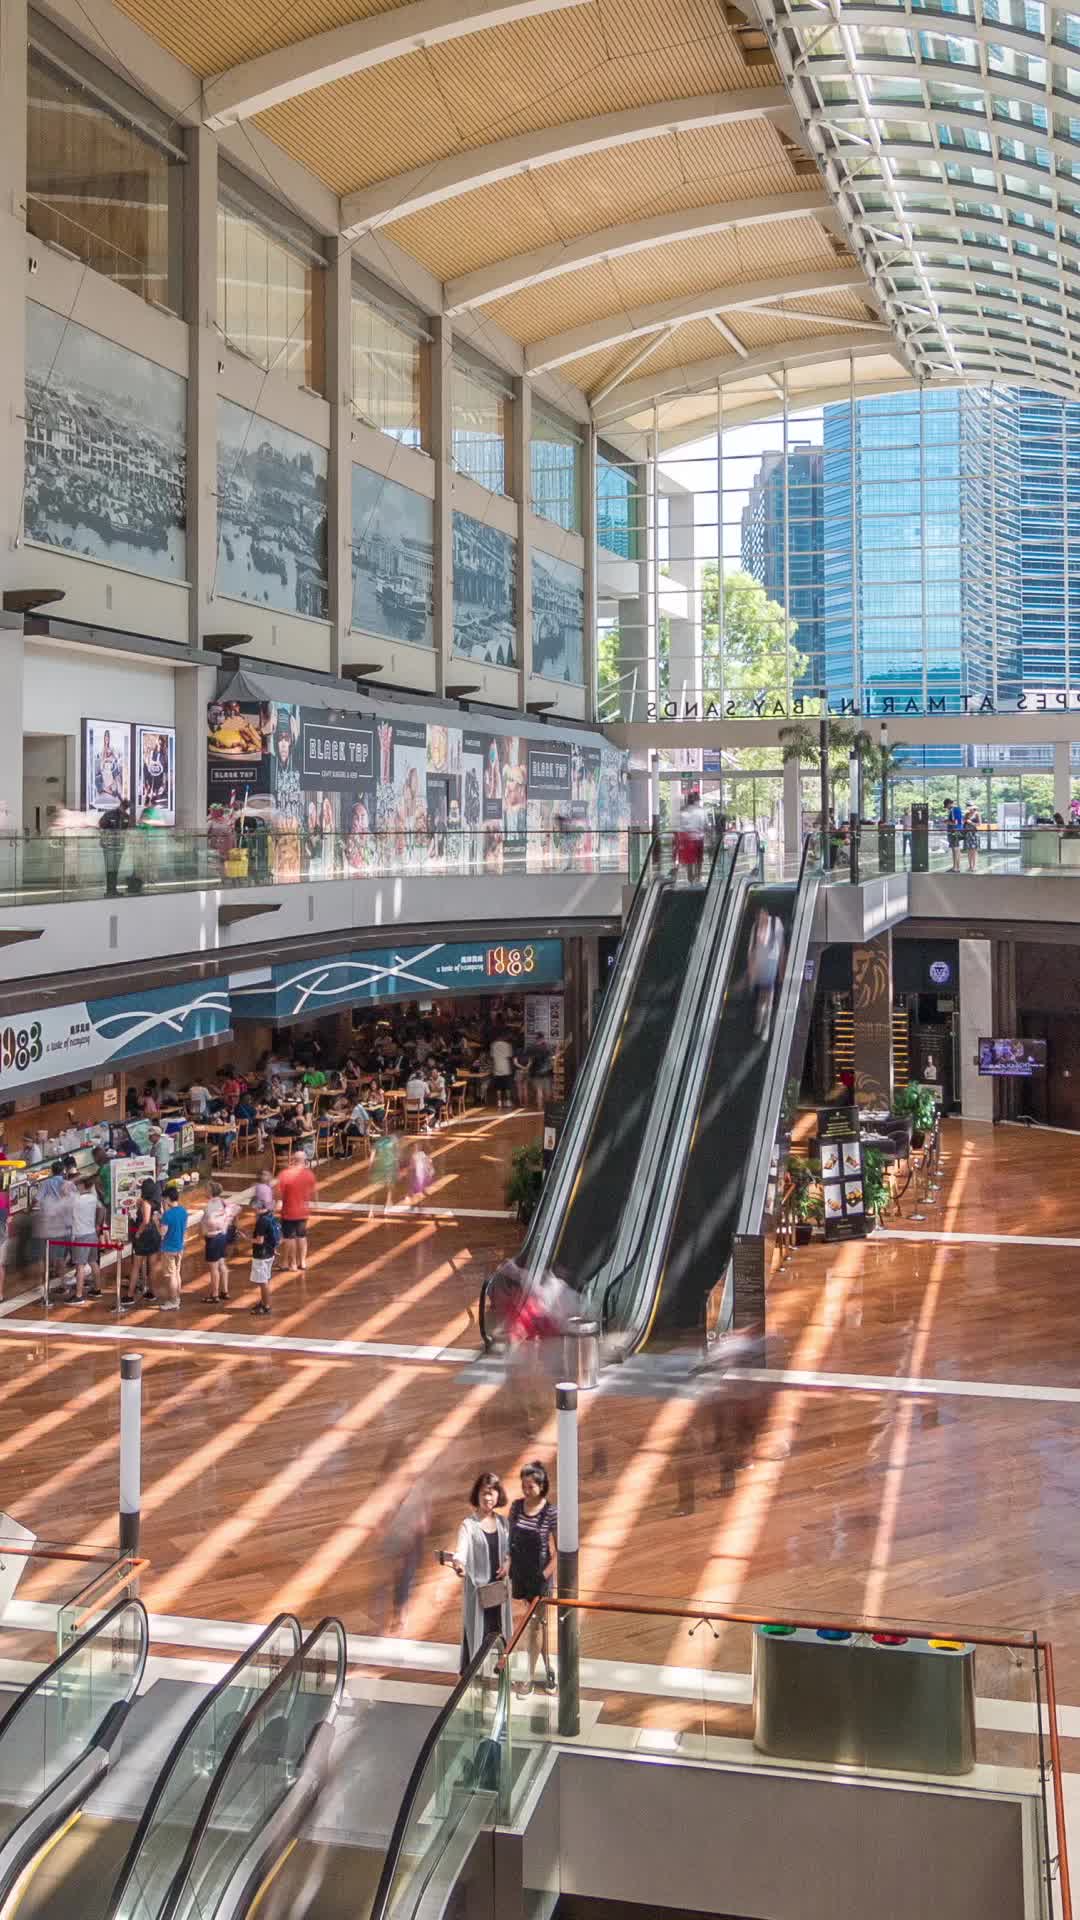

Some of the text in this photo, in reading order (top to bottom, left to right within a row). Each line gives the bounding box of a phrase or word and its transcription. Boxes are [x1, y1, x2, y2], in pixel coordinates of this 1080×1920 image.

[309, 738, 369, 763] BLACK TAP
[213, 771, 239, 779] BLACK
[532, 760, 554, 777] BLACK
[487, 944, 535, 976] 1983
